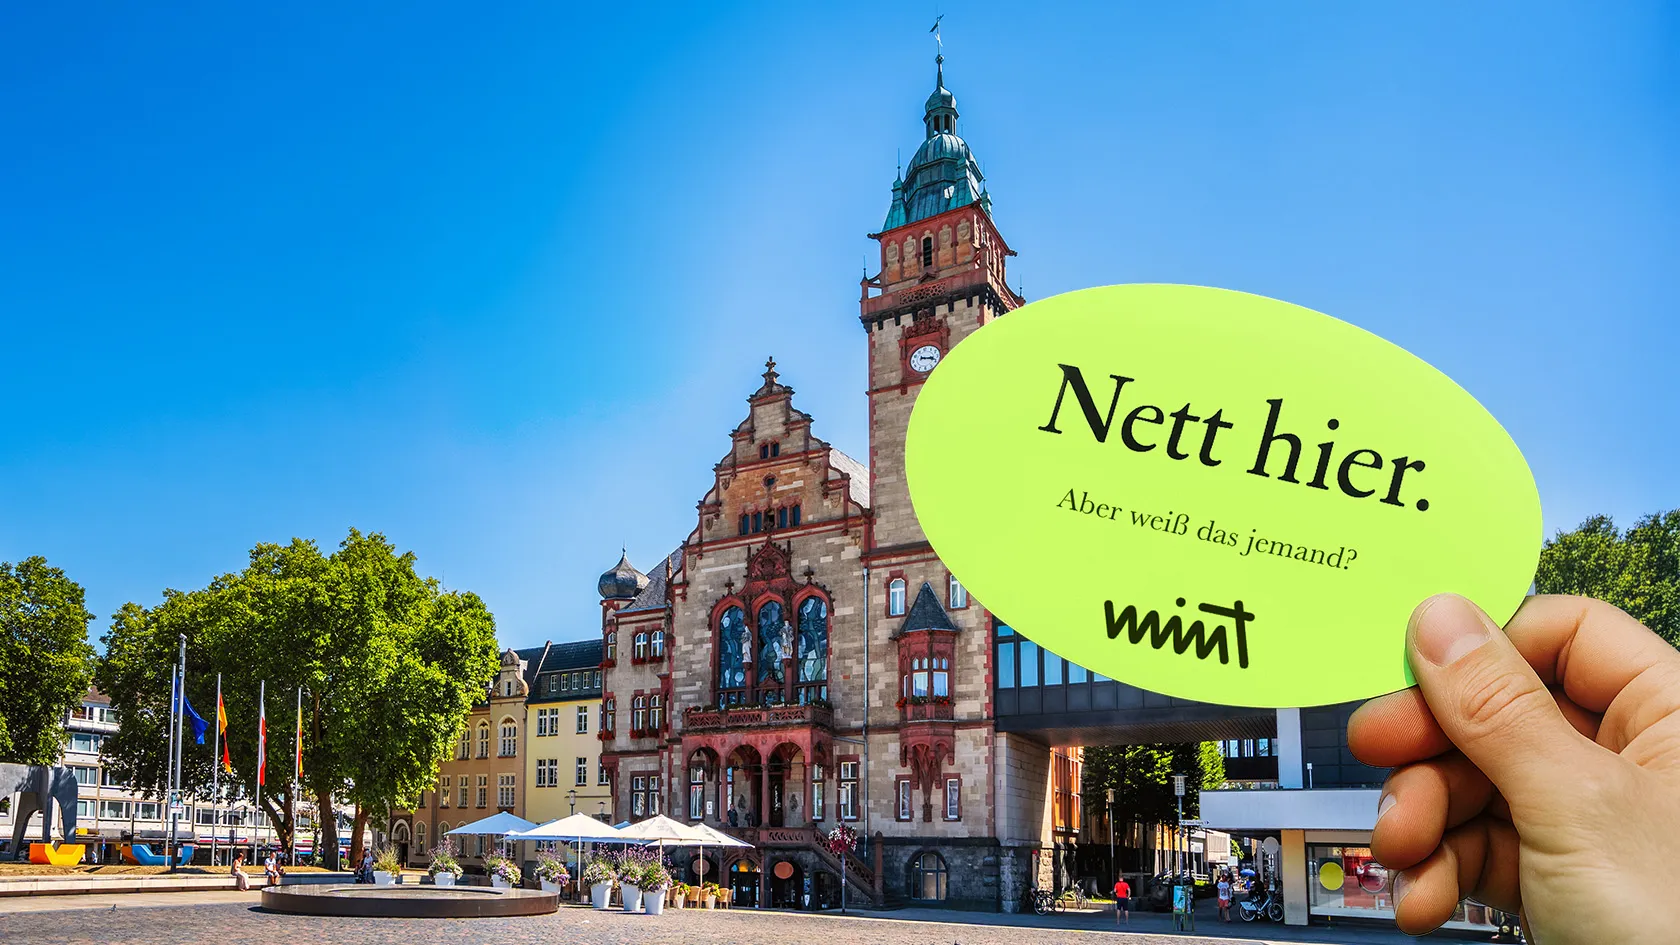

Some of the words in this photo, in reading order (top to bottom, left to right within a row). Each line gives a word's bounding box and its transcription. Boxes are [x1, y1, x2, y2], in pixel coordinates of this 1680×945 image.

[1038, 364, 1233, 466] Nett
[1247, 399, 1430, 511] hier.
[1056, 488, 1122, 521] Aber
[1130, 510, 1189, 536] weiß
[1197, 520, 1239, 547] das
[1240, 529, 1358, 570] jemand?
